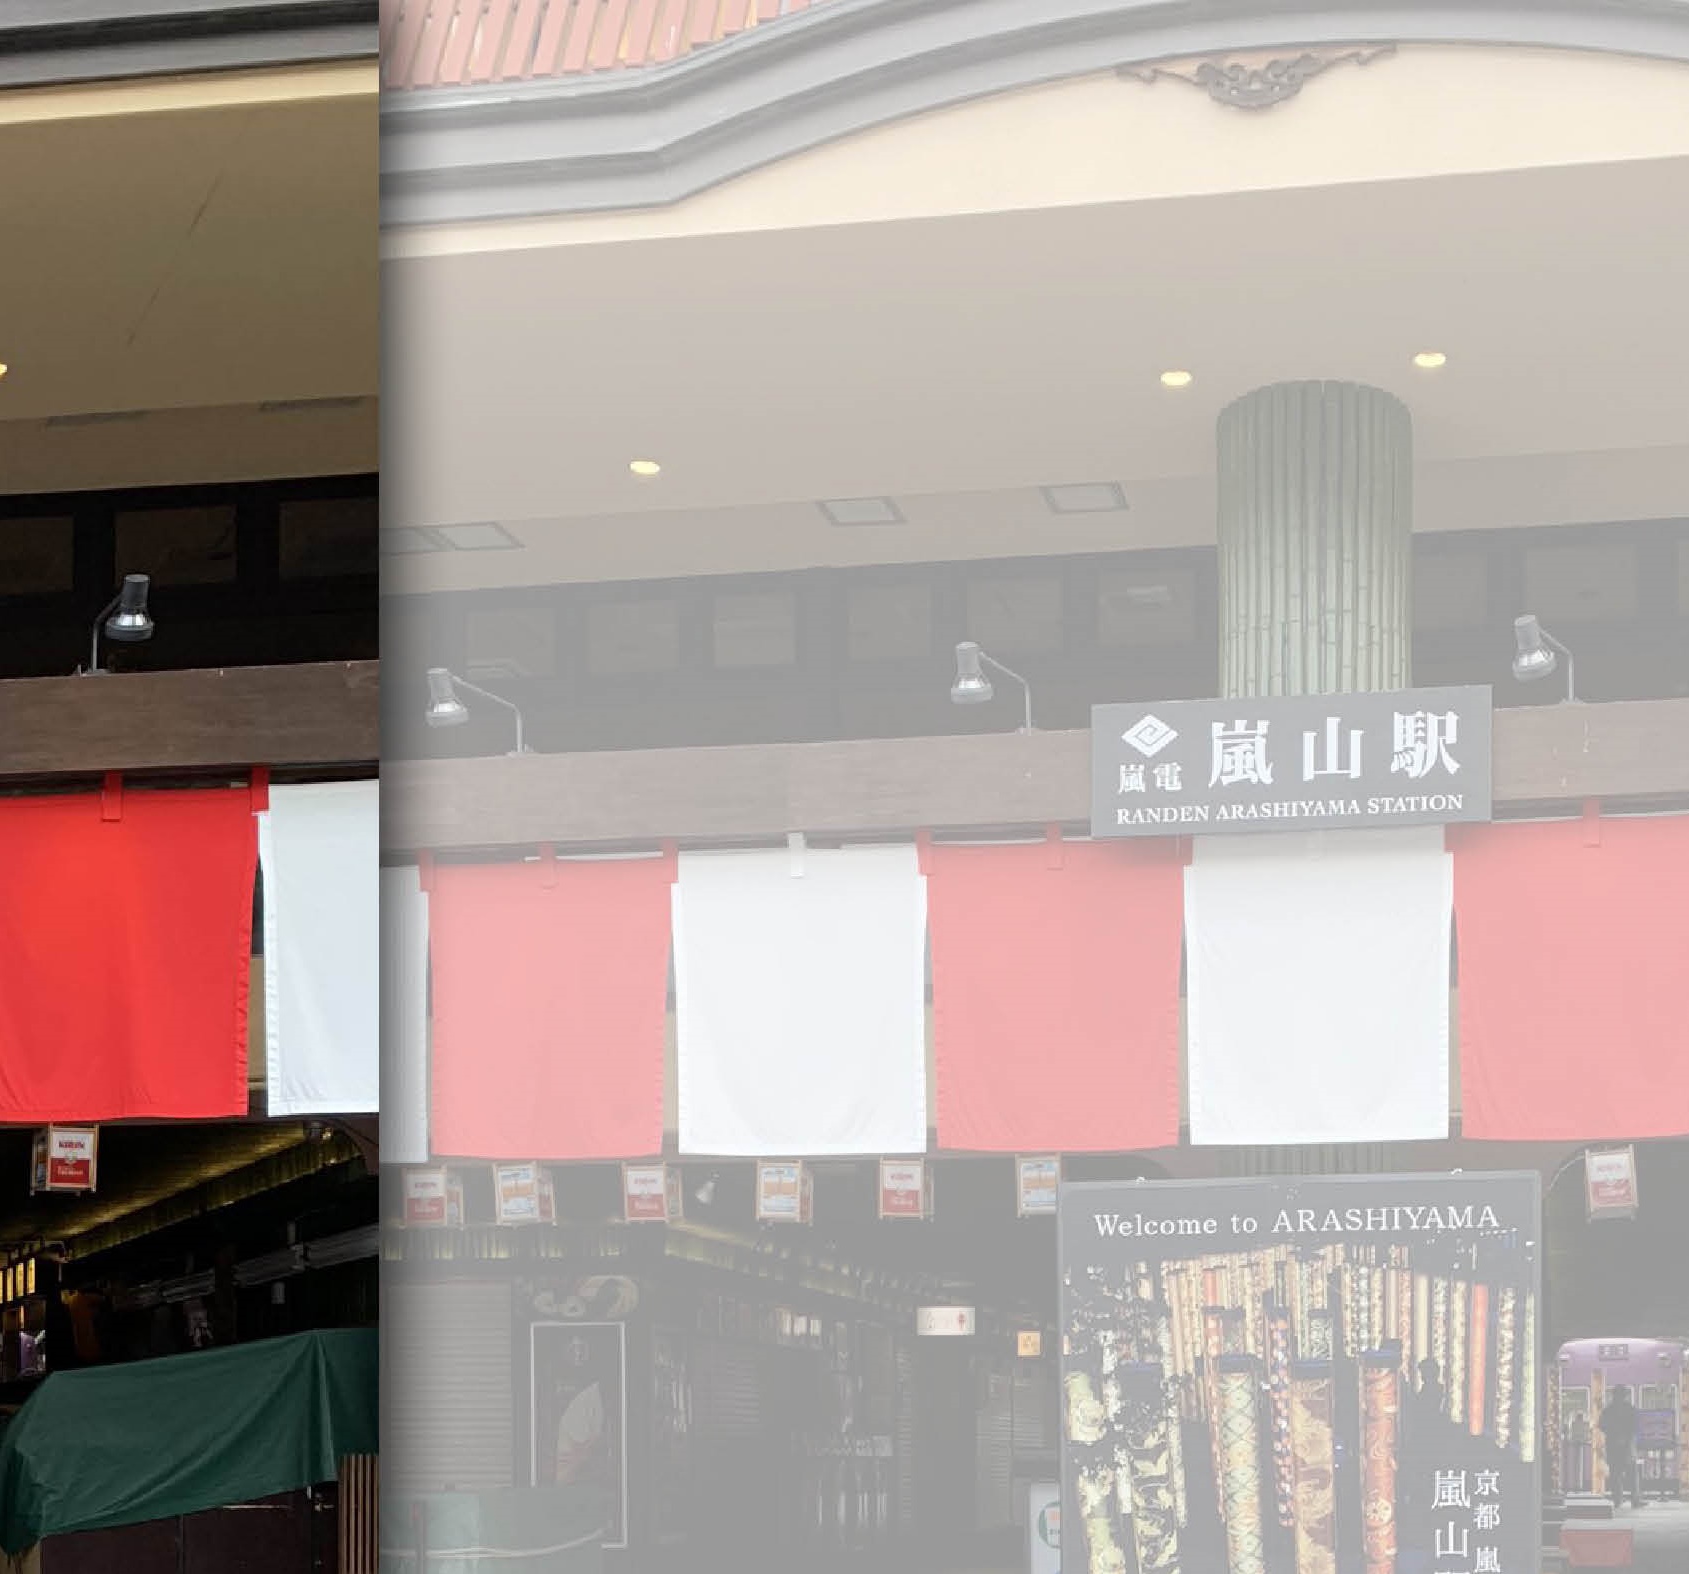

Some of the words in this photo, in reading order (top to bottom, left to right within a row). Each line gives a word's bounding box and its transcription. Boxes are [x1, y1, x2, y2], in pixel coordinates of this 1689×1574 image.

[1209, 710, 1462, 788] 嵐山駅
[1118, 762, 1182, 794] 嵐電
[1117, 805, 1210, 825] RANDEN
[1215, 799, 1362, 820] ARASHIYAMA
[1368, 794, 1464, 814] STATION
[1093, 1212, 1219, 1237] Welcome
[1231, 1214, 1258, 1235] to
[1272, 1205, 1501, 1234] ARASHIYAMA
[1474, 1469, 1502, 1531] 京都
